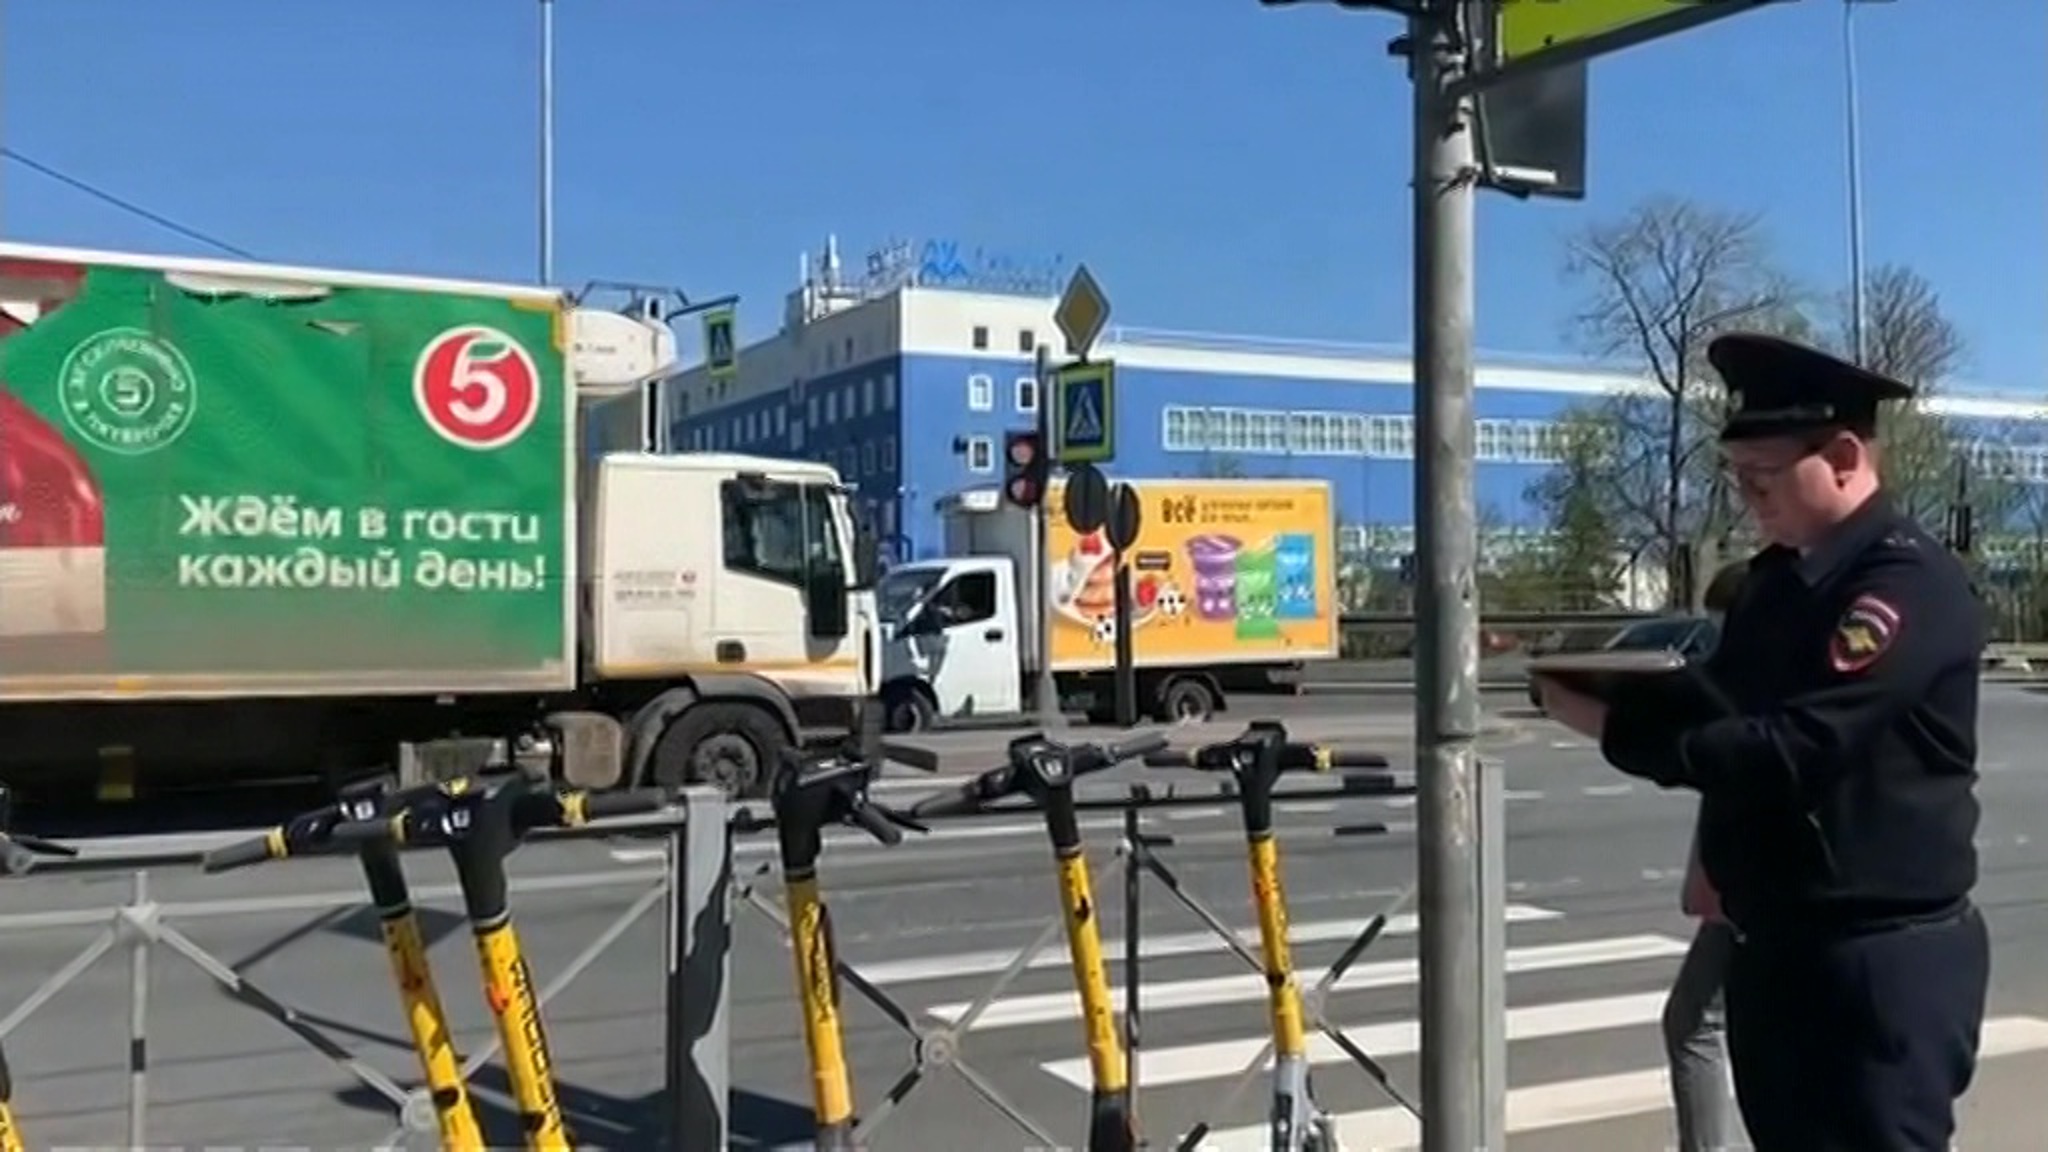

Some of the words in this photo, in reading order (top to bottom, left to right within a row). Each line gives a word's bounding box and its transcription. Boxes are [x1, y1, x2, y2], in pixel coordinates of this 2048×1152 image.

[179, 495, 342, 538] Ждём
[359, 507, 386, 540] в
[403, 508, 540, 543] гости
[179, 547, 401, 589] каждый
[415, 549, 545, 590] день!
